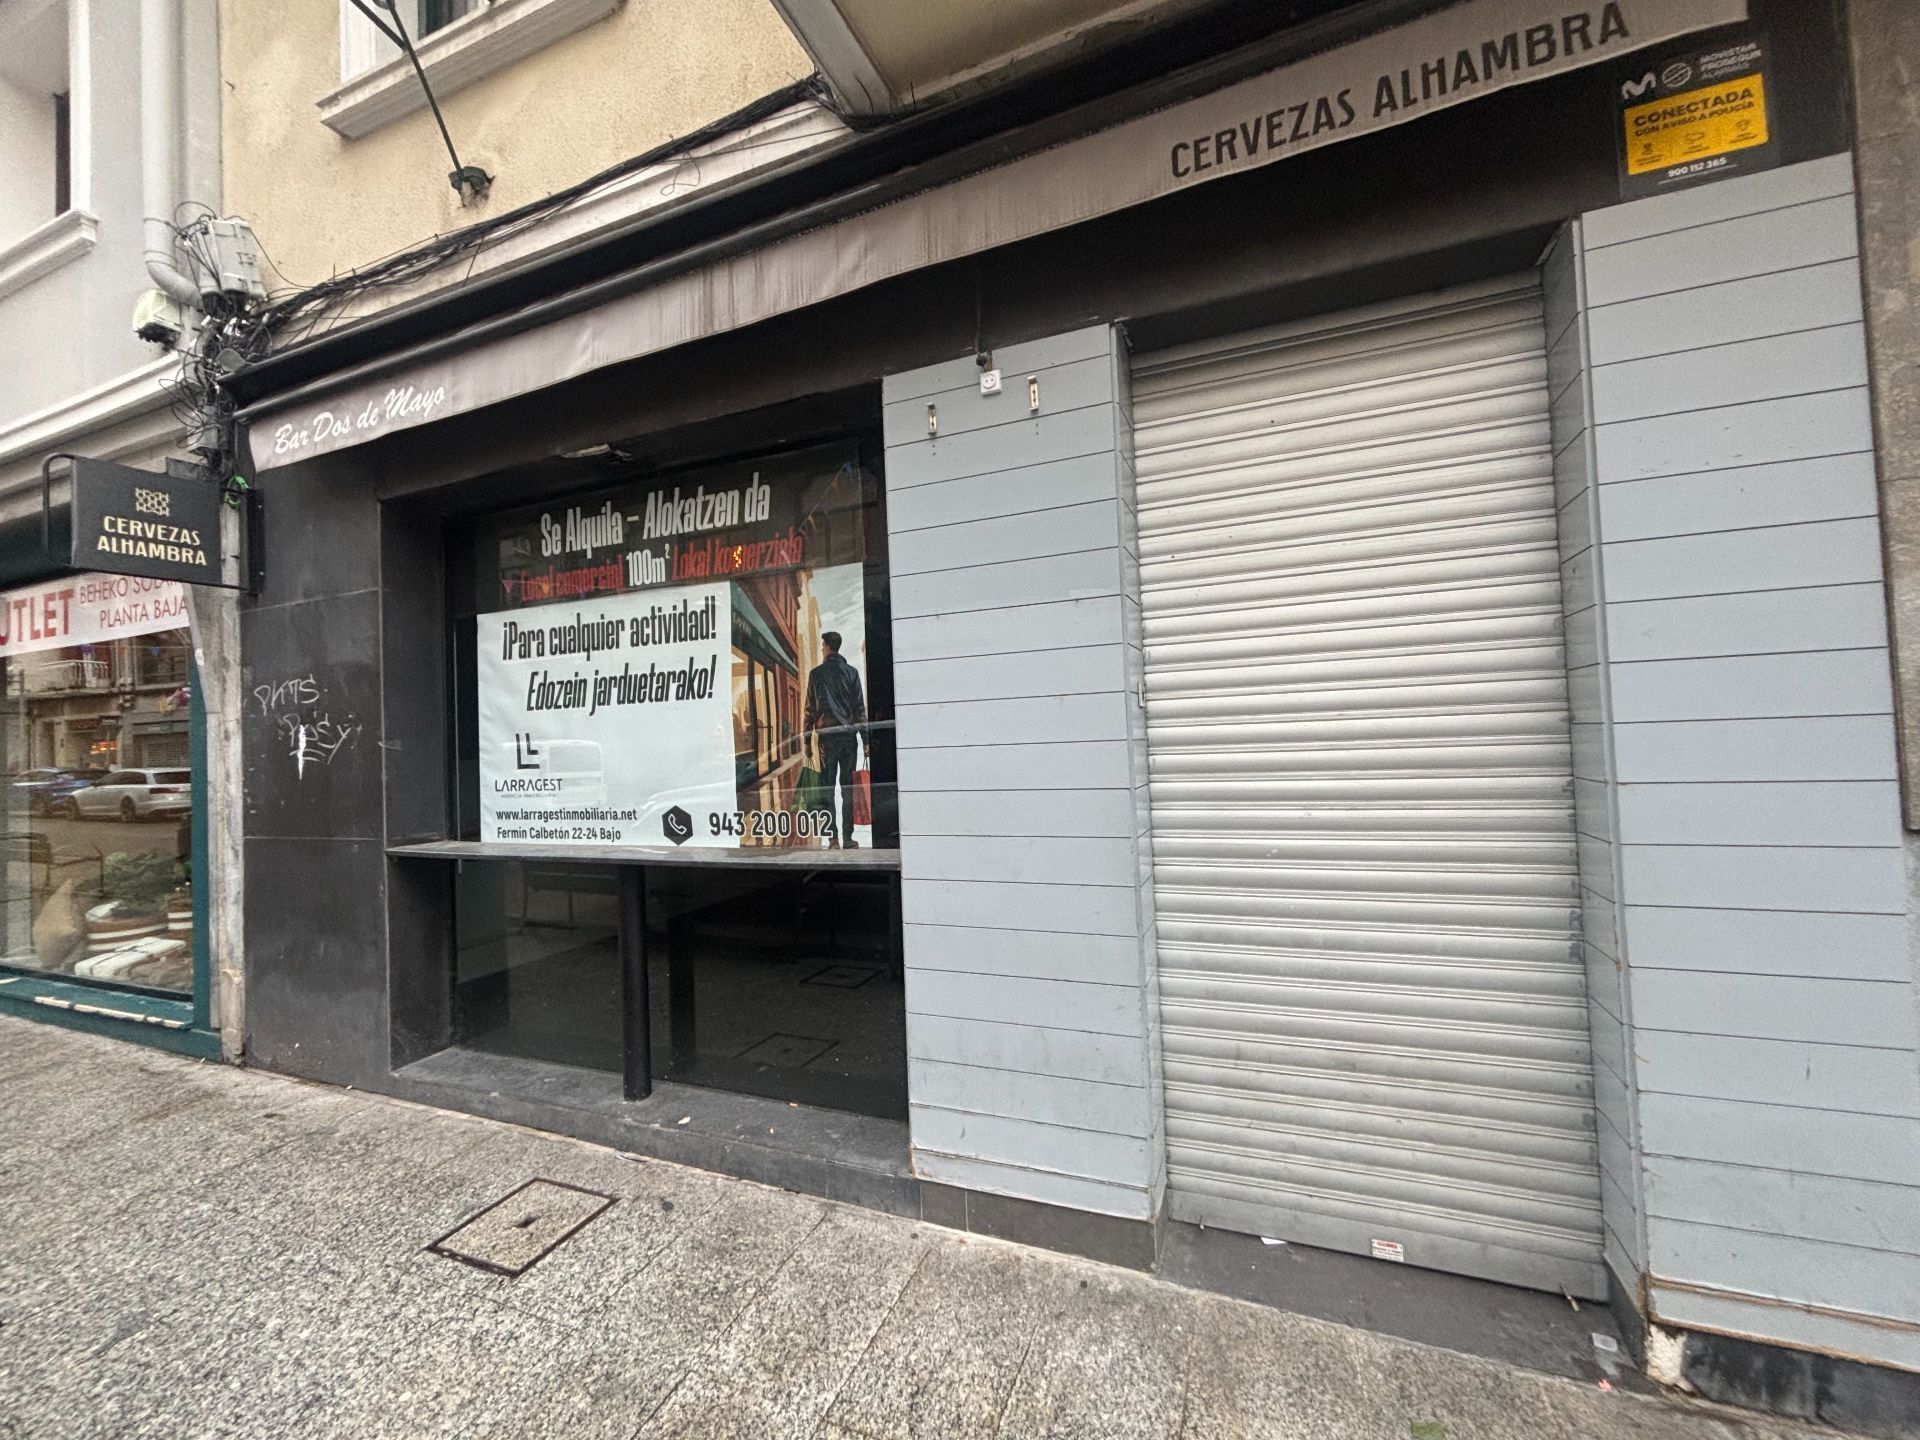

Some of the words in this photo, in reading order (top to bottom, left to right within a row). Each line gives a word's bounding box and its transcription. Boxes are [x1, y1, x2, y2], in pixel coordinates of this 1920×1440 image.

[1170, 89, 1356, 178] CERVEZAS
[1372, 1, 1631, 118] ALHAMBRA
[1634, 87, 1754, 127] CONECTADA
[1635, 125, 1660, 137] CON
[1662, 114, 1697, 131] AVISO
[1668, 166, 1688, 178] 900
[1690, 162, 1705, 172] 112
[275, 423, 309, 454] Bar
[313, 411, 351, 442] Dos
[357, 401, 379, 429] de
[384, 386, 446, 420] Mayo
[103, 515, 201, 546] CERVEZAS
[541, 512, 562, 557] Se
[565, 501, 624, 559] Alquila
[643, 485, 740, 540] Alokatzen
[744, 472, 771, 523] da
[97, 535, 207, 566] ALHAMBRA
[672, 539, 711, 580] Lokal
[80, 577, 129, 604] BEHEKO
[100, 603, 150, 629] PLANTA
[154, 594, 188, 619] BAJA
[502, 621, 545, 661] ¡Para
[549, 613, 625, 661] cualquier
[630, 595, 717, 648] actividad!
[526, 670, 588, 712] Edozein
[589, 654, 718, 717] jarduetarako!
[494, 778, 563, 792] LARRAGEST
[496, 807, 638, 823] www.larragestinmobiliaria.net
[709, 811, 746, 837] 943
[750, 810, 791, 838] 200
[797, 809, 833, 838] 012
[497, 826, 527, 839] Fermín
[529, 826, 569, 840] Calbetón
[572, 827, 598, 840] 22-24
[600, 827, 621, 842] Bajo
